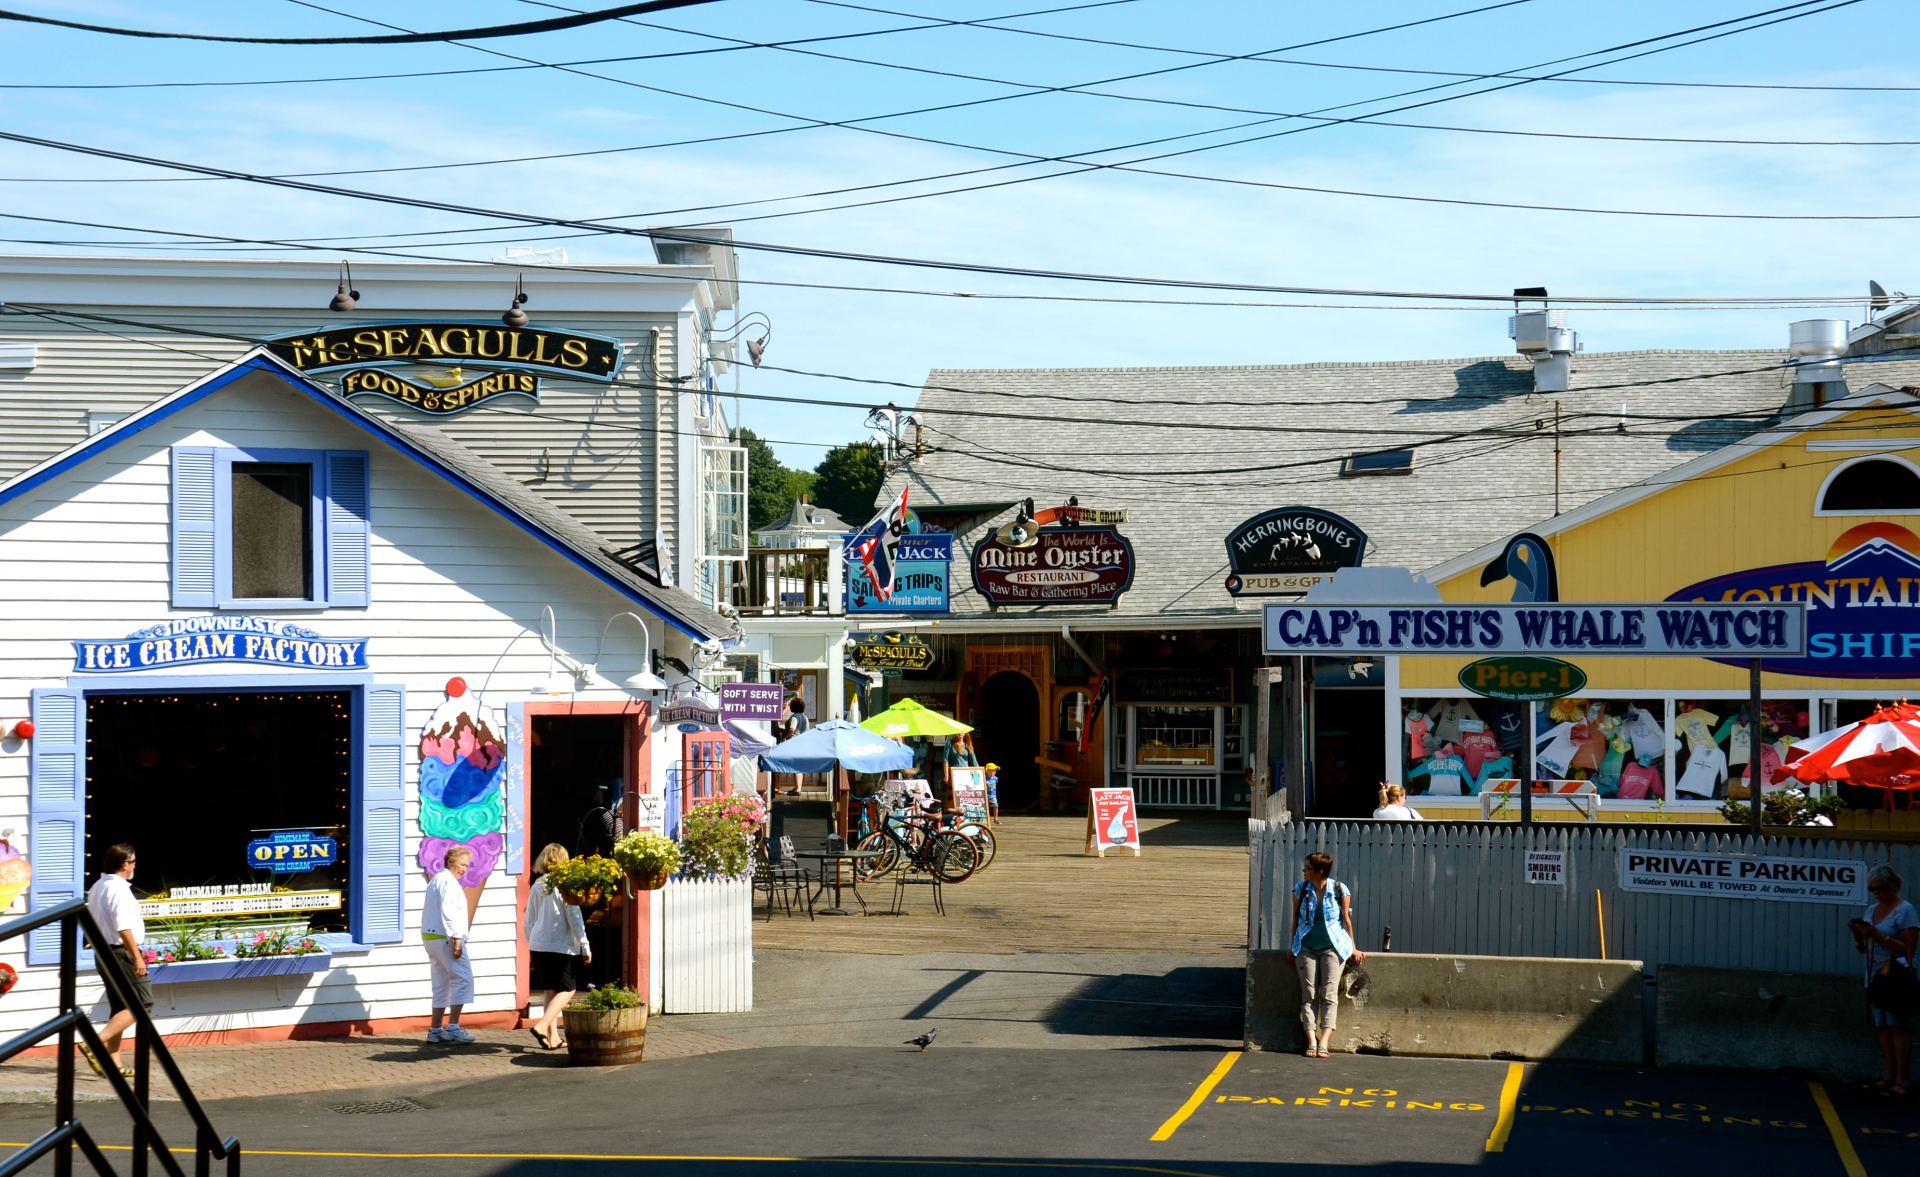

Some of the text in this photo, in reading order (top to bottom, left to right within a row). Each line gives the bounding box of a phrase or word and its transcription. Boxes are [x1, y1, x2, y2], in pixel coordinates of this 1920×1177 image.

[292, 327, 590, 369] McSEAGULLS
[346, 370, 535, 411] FOOD & SPIRITS
[1100, 512, 1124, 523] GRILL
[1042, 533, 1060, 547] The
[1062, 533, 1095, 547] World
[1235, 516, 1356, 553] HERRINGBONES
[900, 546, 947, 560] JACK
[978, 545, 1124, 570] Mine Oyster
[905, 573, 943, 592] TRIPS
[1016, 571, 1086, 583] RESTAURANT
[1245, 577, 1281, 589] PUB
[1282, 577, 1298, 588] &
[989, 581, 1117, 599] Raw Bar & Gathering Place
[913, 595, 942, 606] Charters
[172, 615, 278, 634] DOWNEAST
[1278, 609, 1787, 648] CAP'n FISH'S WHALE WATCH
[84, 632, 361, 669] ICE CREAM FACTORY
[860, 645, 927, 659] McSEAGULLS
[723, 689, 780, 700] SOFT SERVE
[723, 703, 779, 713] WITH TWIST
[661, 708, 719, 724] ICE CREAM FACTORY
[508, 778, 516, 790] 3
[508, 822, 515, 834] 2
[274, 833, 310, 843] HOMEMADE
[255, 842, 331, 861] OPEN
[1528, 853, 1561, 861] DESIGNATED
[275, 861, 311, 871] ICE CREAM
[1528, 863, 1561, 873] SMOKING
[1629, 855, 1856, 884] PRIVATE PARKING
[1531, 872, 1558, 881] AREA
[170, 882, 271, 899] HOMEMADE ICE CREAM
[1633, 876, 1667, 886] Violators
[1670, 879, 1696, 888] WILL
[1700, 881, 1714, 889] BE
[1718, 881, 1757, 892] TOWED
[1760, 884, 1771, 892] At
[1773, 884, 1806, 895] Owner's
[1809, 887, 1845, 897] Expense
[291, 895, 329, 908] LEMONADE
[1318, 1086, 1398, 1096] NO
[1215, 1095, 1485, 1111] PARKING
[1625, 1099, 1709, 1111] NO
[1520, 1104, 1808, 1128] PARKING
